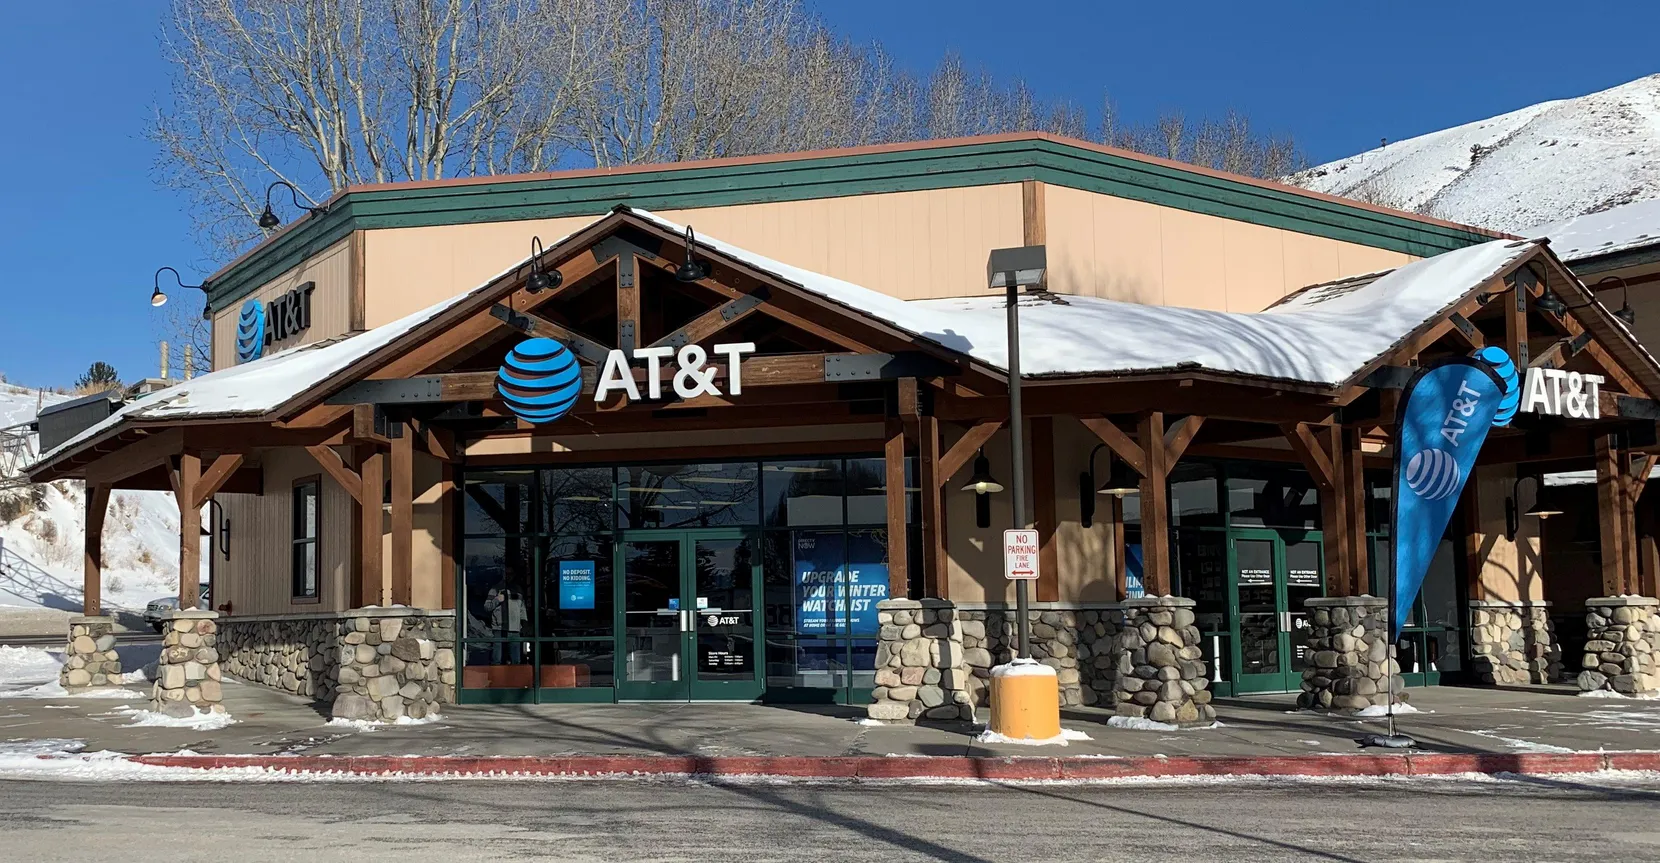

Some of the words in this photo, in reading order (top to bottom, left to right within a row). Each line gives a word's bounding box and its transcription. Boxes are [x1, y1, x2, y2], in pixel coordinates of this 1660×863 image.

[263, 281, 315, 346] AT&T
[594, 342, 756, 402] AT&T
[1520, 367, 1605, 420] AT&T
[1440, 380, 1481, 447] AT&T
[1016, 534, 1028, 544] NO
[1008, 545, 1036, 554] PARKING
[803, 585, 834, 598] YOUR
[838, 584, 886, 597] WINTER
[803, 599, 871, 612] WATCHIST
[719, 616, 740, 625] AT&T
